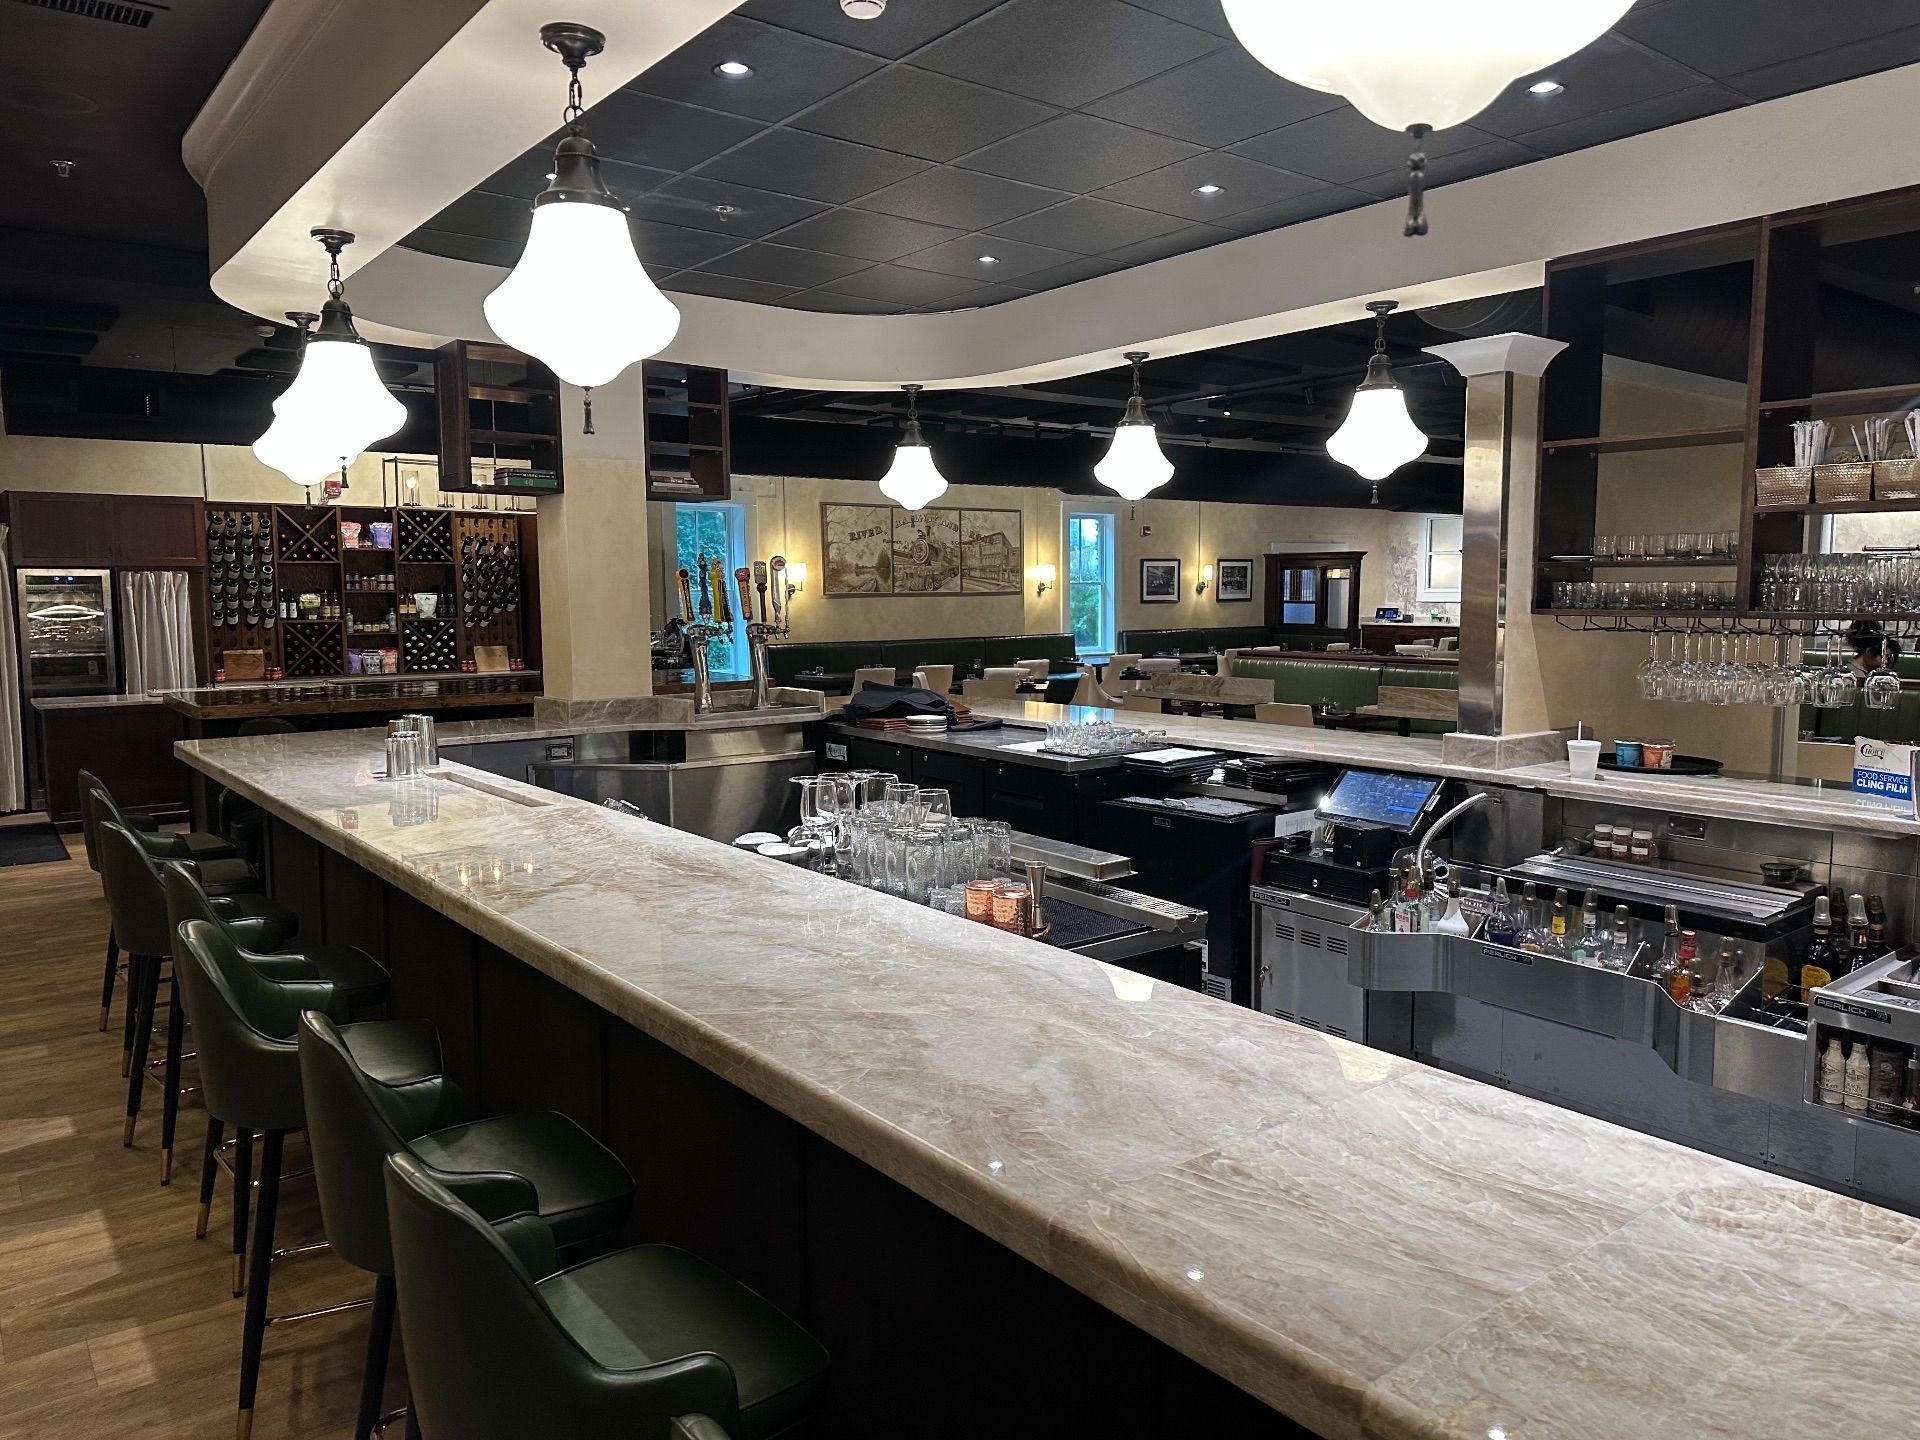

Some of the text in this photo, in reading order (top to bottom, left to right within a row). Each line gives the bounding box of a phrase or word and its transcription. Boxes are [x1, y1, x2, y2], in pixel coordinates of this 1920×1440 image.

[1857, 770, 1909, 785] FOOD SERVICE
[1856, 778, 1908, 794] CLING FILM
[1254, 892, 1287, 905] PERLICK
[1483, 948, 1518, 961] PERLICK
[1817, 998, 1868, 1017] PERLICK
